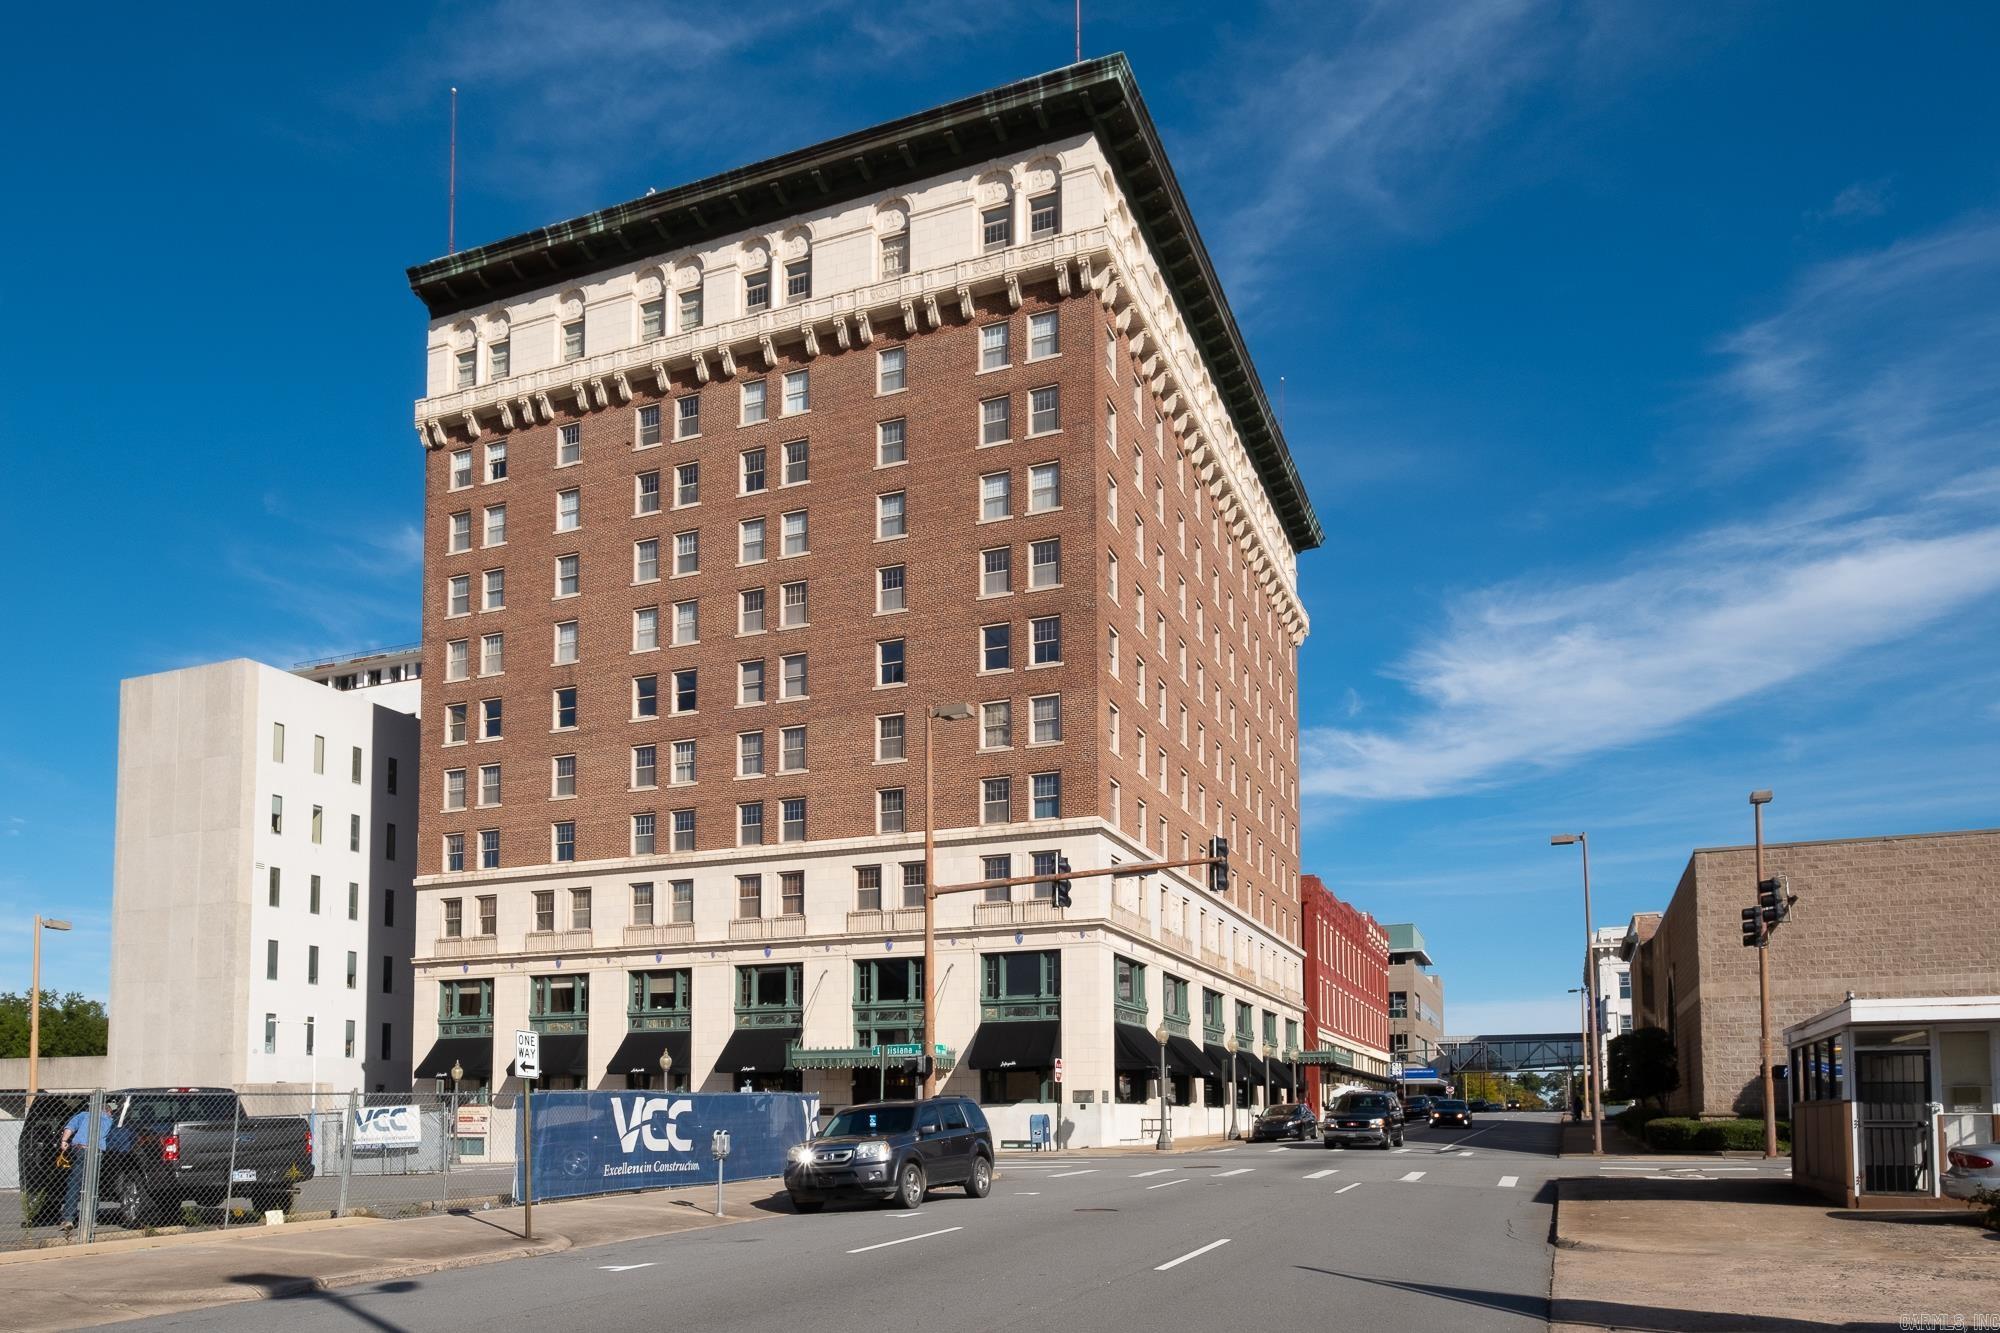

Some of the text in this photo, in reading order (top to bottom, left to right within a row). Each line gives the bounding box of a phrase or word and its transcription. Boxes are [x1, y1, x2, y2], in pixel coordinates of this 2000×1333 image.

[518, 1034, 536, 1047] ONE
[518, 1047, 536, 1059] WAY
[877, 1044, 913, 1055] Lisiana
[355, 1107, 408, 1133] VCC
[610, 1096, 693, 1153] VCC
[603, 1161, 644, 1177] Excellenc
[644, 1161, 652, 1173] in
